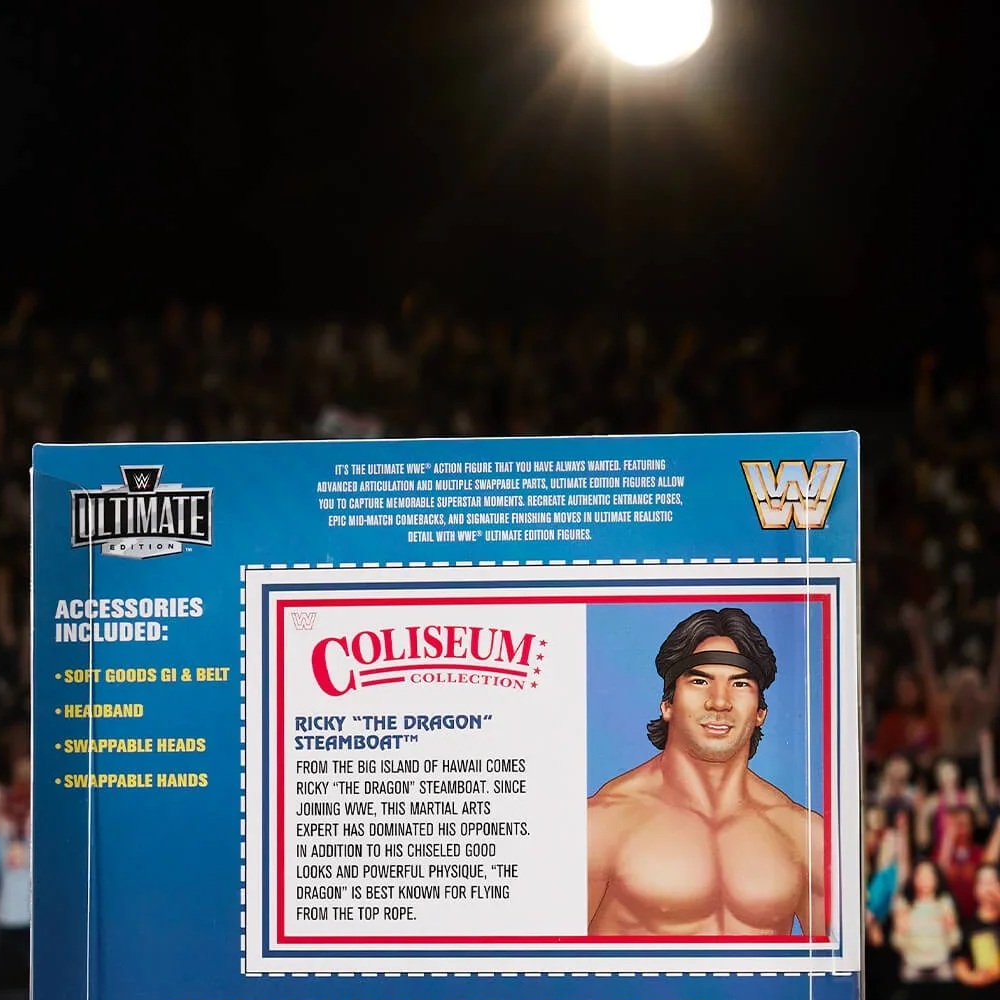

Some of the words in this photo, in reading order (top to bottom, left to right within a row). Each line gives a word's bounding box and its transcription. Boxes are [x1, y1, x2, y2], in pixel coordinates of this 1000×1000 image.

[79, 496, 205, 538] ULTIMATE
[328, 515, 346, 526] EPIC
[348, 514, 393, 526] MID-MATCH
[395, 513, 446, 526] COMEBACKS,
[447, 513, 464, 524] AND
[466, 512, 509, 524] SIGNATURE
[511, 512, 551, 523] FINISHING
[553, 511, 581, 523] MOVES
[583, 511, 592, 522] IN
[594, 511, 631, 522] ULTIMATE
[633, 510, 672, 522] REALISTIC
[55, 597, 203, 619] ACCESSORIES
[55, 622, 168, 642] INCLUDED:
[311, 625, 536, 697] COLISEUM
[64, 669, 101, 683] SOFT
[104, 667, 156, 682] GOODS
[160, 667, 176, 682] GI
[180, 667, 192, 682] &
[195, 666, 229, 681] BELT
[410, 673, 526, 690] COLLECTION
[64, 703, 143, 718] HEADBAND
[294, 715, 346, 732] RICKY
[64, 738, 152, 753] SWAPPABLE
[156, 737, 206, 752] HEADS
[296, 760, 327, 774] FROM
[331, 759, 353, 773] THE
[357, 759, 376, 773] BIG
[380, 759, 419, 773] ISLAND
[423, 759, 438, 773] OF
[442, 759, 481, 773] HAWAII
[486, 758, 525, 772] COMES
[64, 773, 152, 788] SWAPPABLE
[156, 773, 208, 787] HANDS
[295, 801, 340, 816] JOINING
[344, 801, 376, 817] WWE,
[380, 801, 405, 815] THIS
[410, 801, 458, 815] MARTIAL
[461, 800, 490, 815] ARTS
[296, 822, 339, 837] EXPERT
[343, 822, 364, 836] HAS
[369, 822, 433, 836] DOMINATED
[438, 822, 456, 836] HIS
[460, 821, 530, 836] OPPONENTS.
